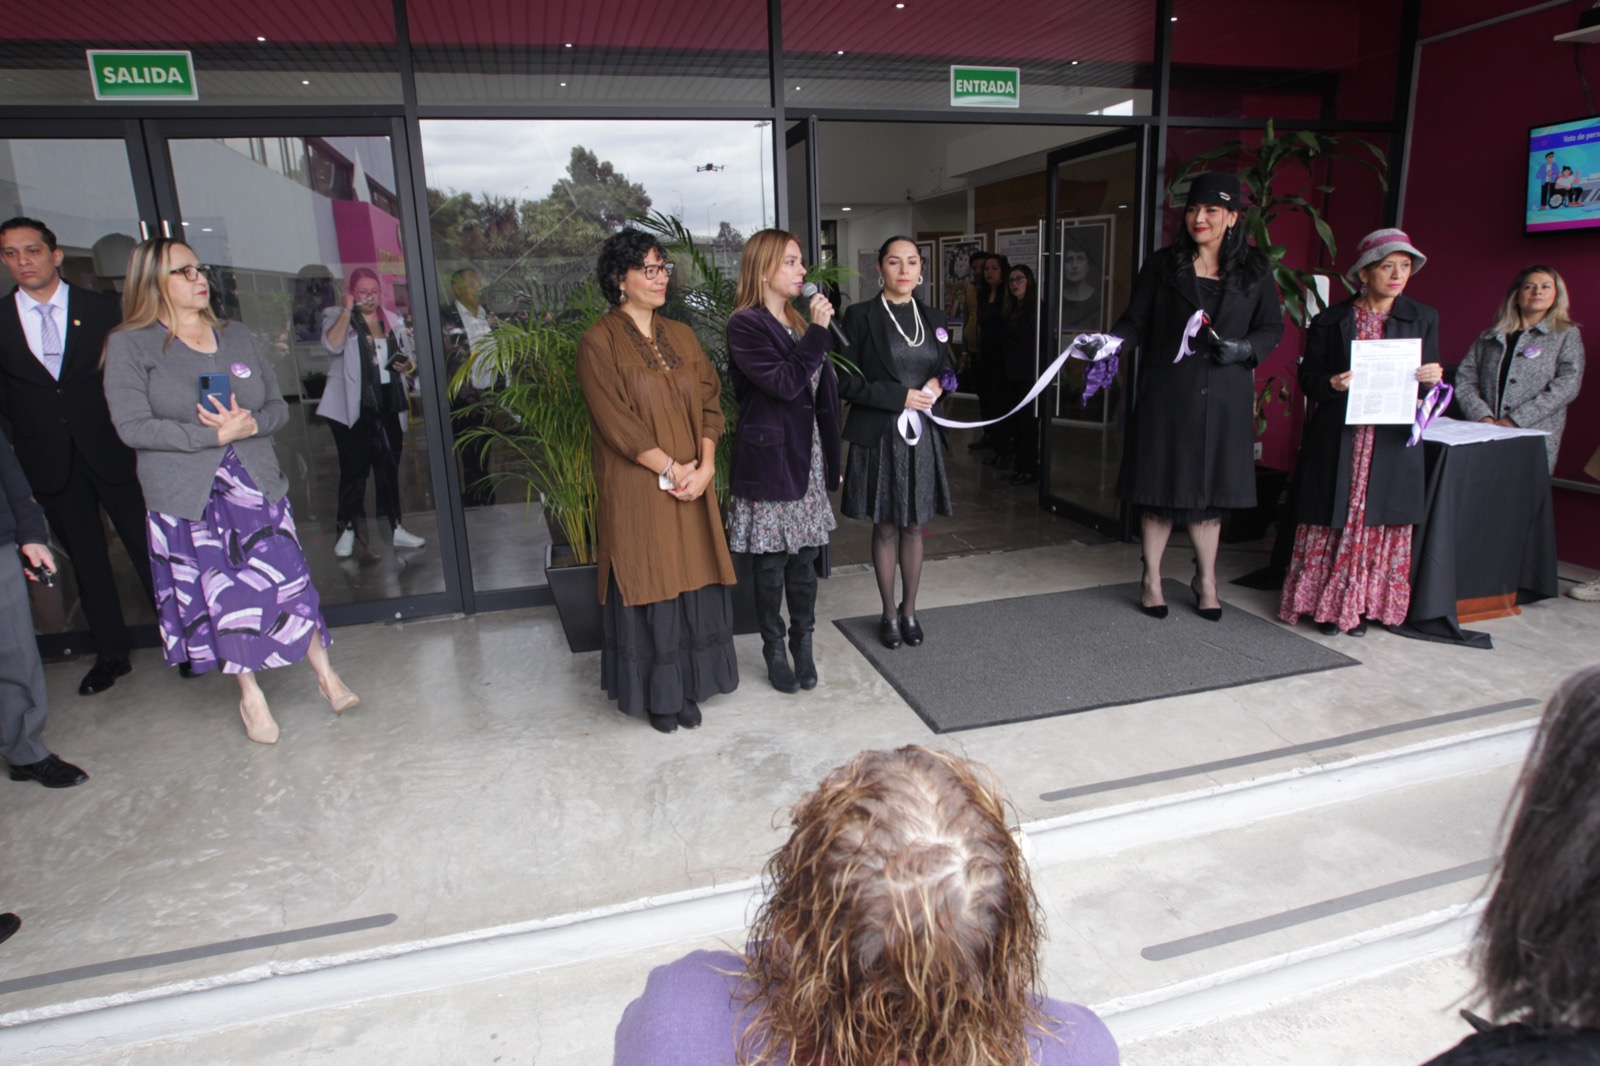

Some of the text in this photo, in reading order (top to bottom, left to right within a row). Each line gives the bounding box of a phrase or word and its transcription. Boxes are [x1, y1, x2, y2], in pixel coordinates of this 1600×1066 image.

[104, 67, 184, 83] SALIDA
[956, 79, 1014, 93] ENTRADA
[1563, 135, 1576, 143] Voto
[1577, 132, 1585, 141] de
